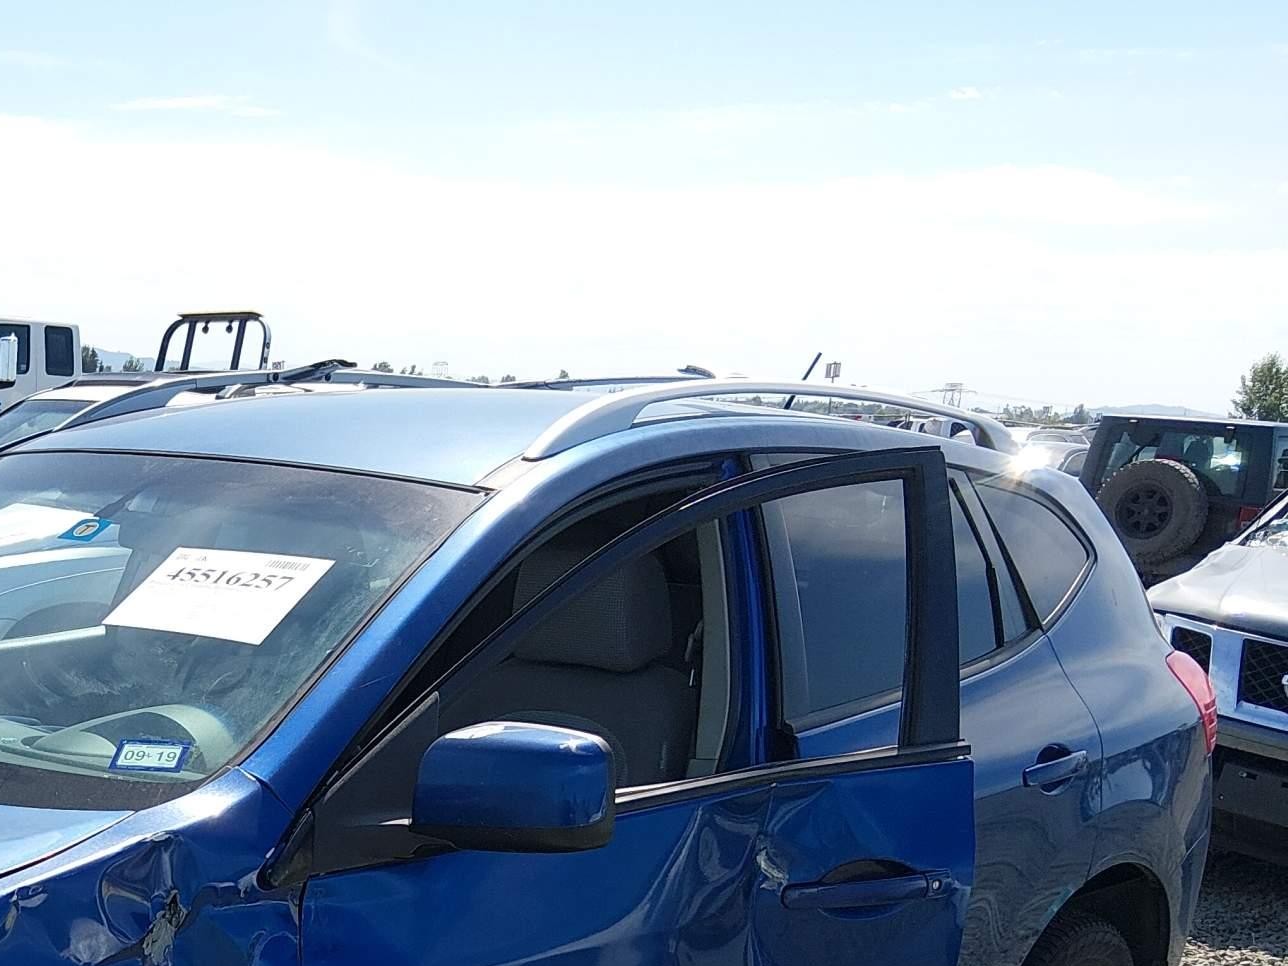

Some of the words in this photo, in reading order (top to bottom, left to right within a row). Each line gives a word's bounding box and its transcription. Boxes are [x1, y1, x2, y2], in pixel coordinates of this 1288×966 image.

[167, 567, 295, 591] 45516257
[123, 750, 146, 762] 09
[156, 751, 178, 763] 19
